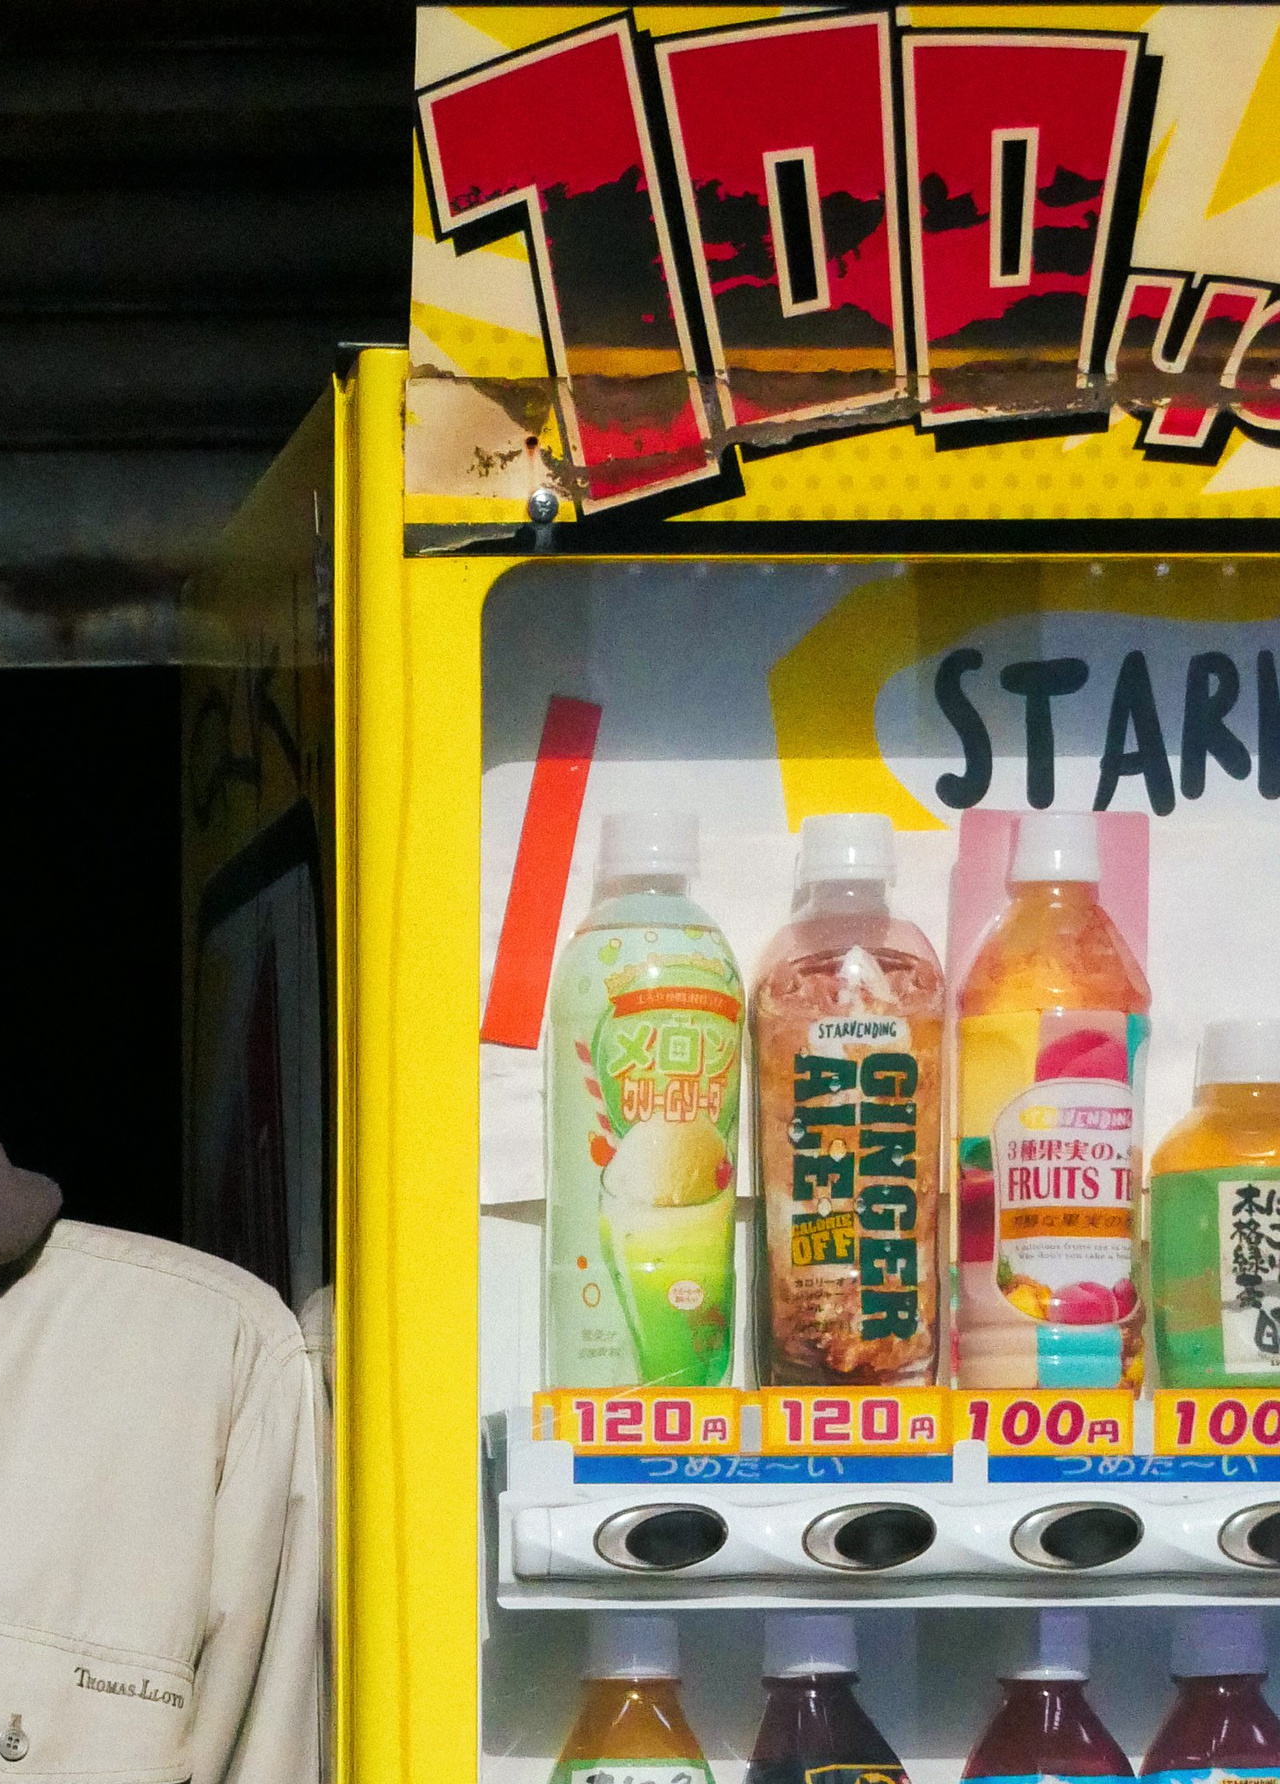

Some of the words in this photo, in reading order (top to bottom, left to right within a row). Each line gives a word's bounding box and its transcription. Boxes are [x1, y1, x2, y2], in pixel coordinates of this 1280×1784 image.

[415, 8, 1162, 518] 100
[607, 1021, 736, 1078] メロン
[818, 1021, 897, 1039] STARVENDING
[793, 1054, 857, 1201] ALE
[859, 1053, 919, 1341] GINGER
[1008, 1166, 1100, 1201] FRUITS
[792, 1213, 853, 1238] CALORIE
[792, 1228, 855, 1266] OFF
[1231, 1184, 1269, 1309] 本格緑茶
[573, 1400, 728, 1443] 120円
[782, 1399, 936, 1442] 120円
[968, 1400, 1120, 1446] 100円
